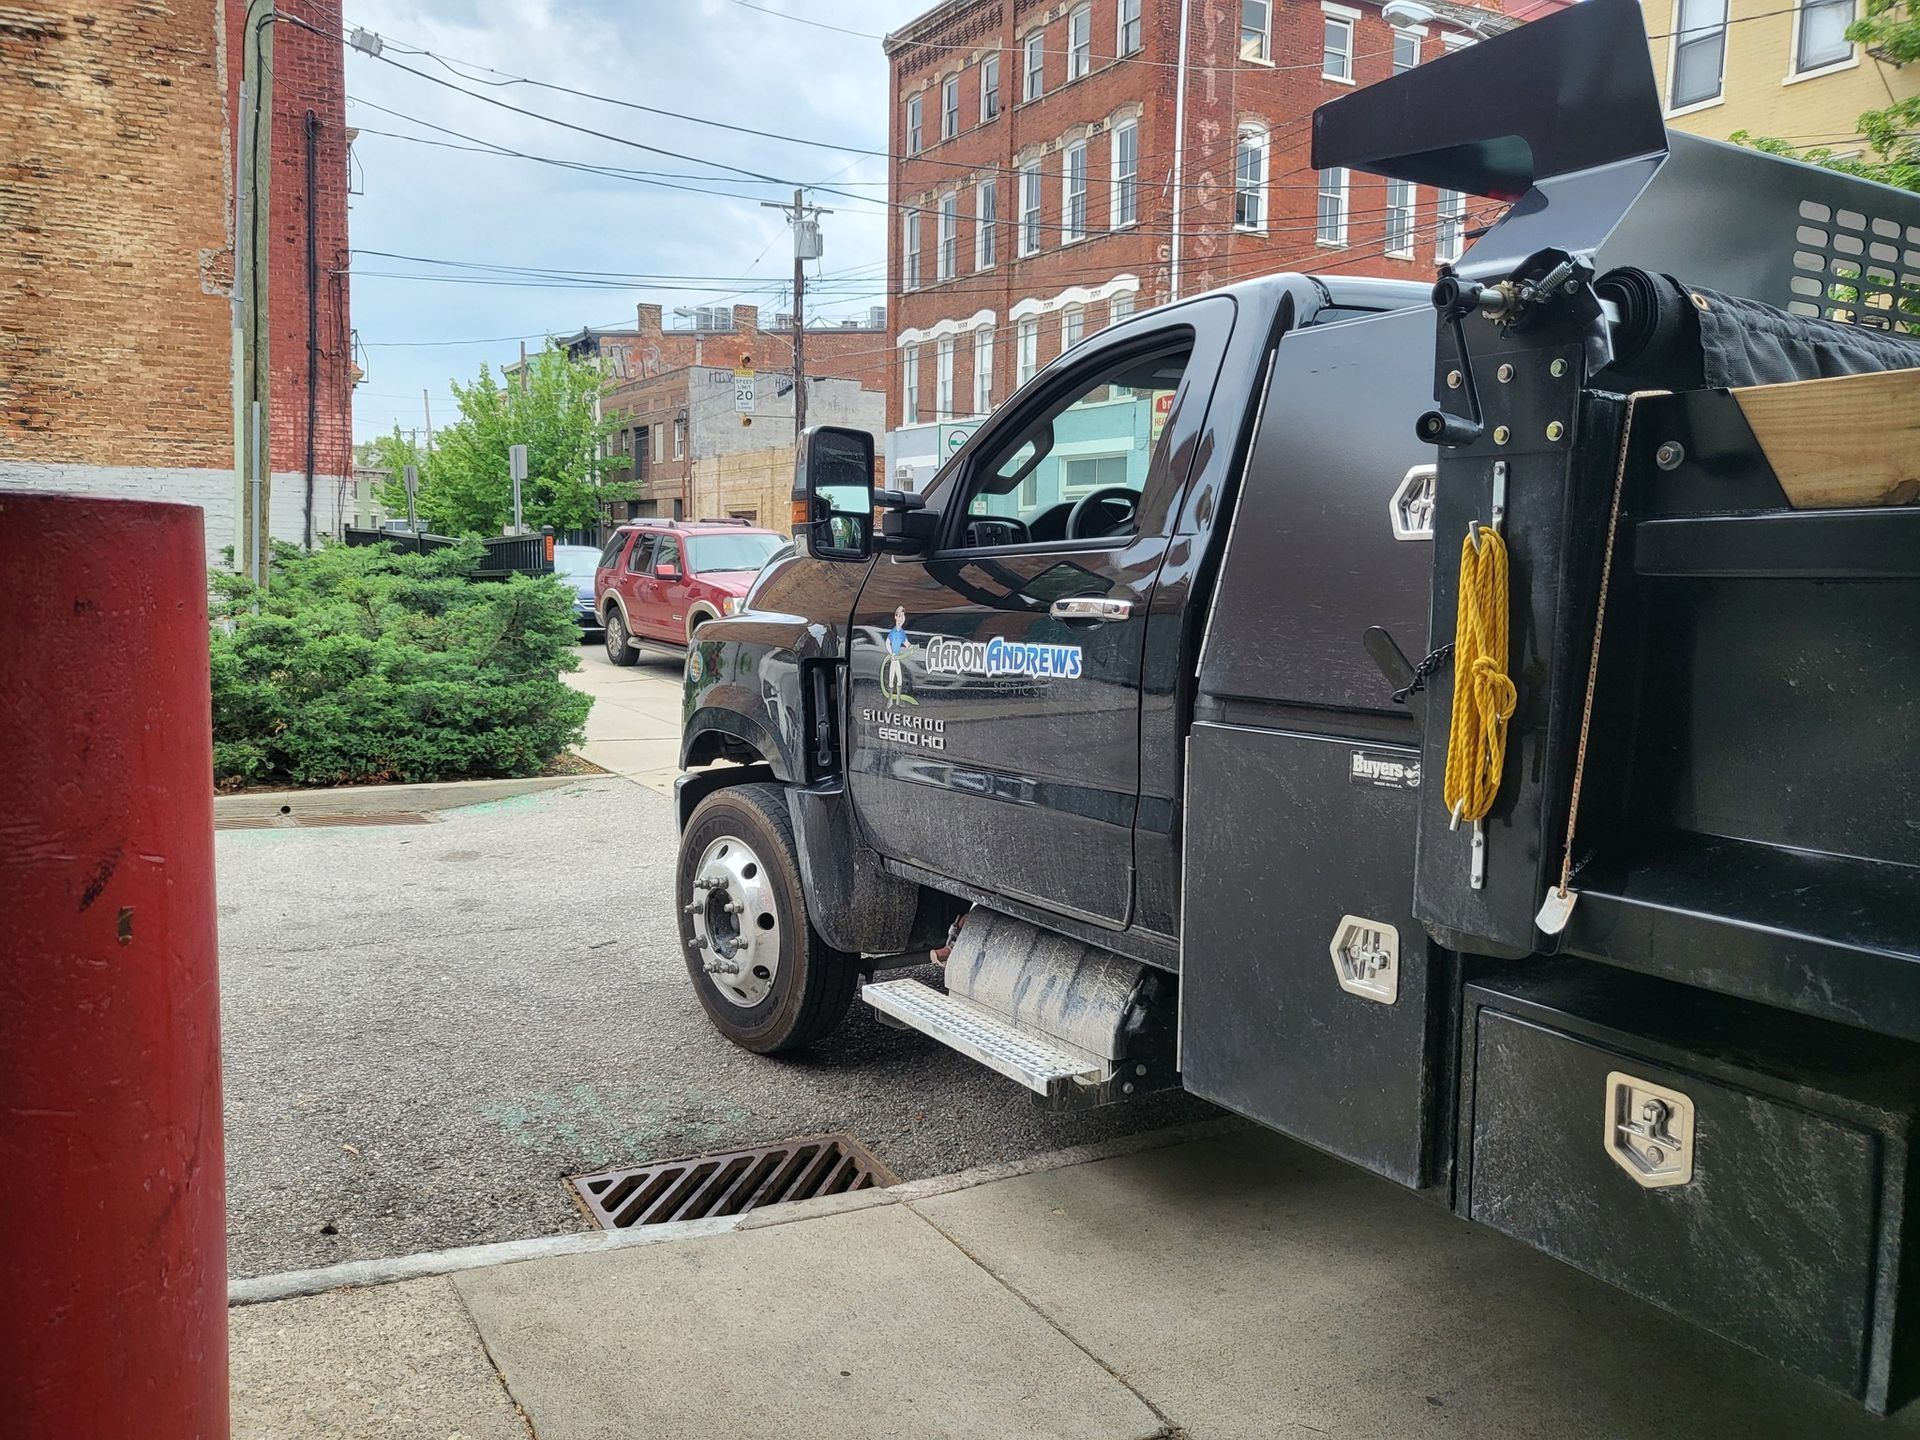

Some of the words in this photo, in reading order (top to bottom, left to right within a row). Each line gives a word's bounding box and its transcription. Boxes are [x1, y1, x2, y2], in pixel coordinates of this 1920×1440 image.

[736, 390, 754, 401] 20
[984, 636, 1082, 679] ANDREWS
[993, 681, 1030, 697] SEPTIC
[863, 708, 945, 733] SILVERADO
[878, 727, 919, 745] 5500
[920, 734, 945, 750] HD
[1352, 754, 1404, 779] Buyers
